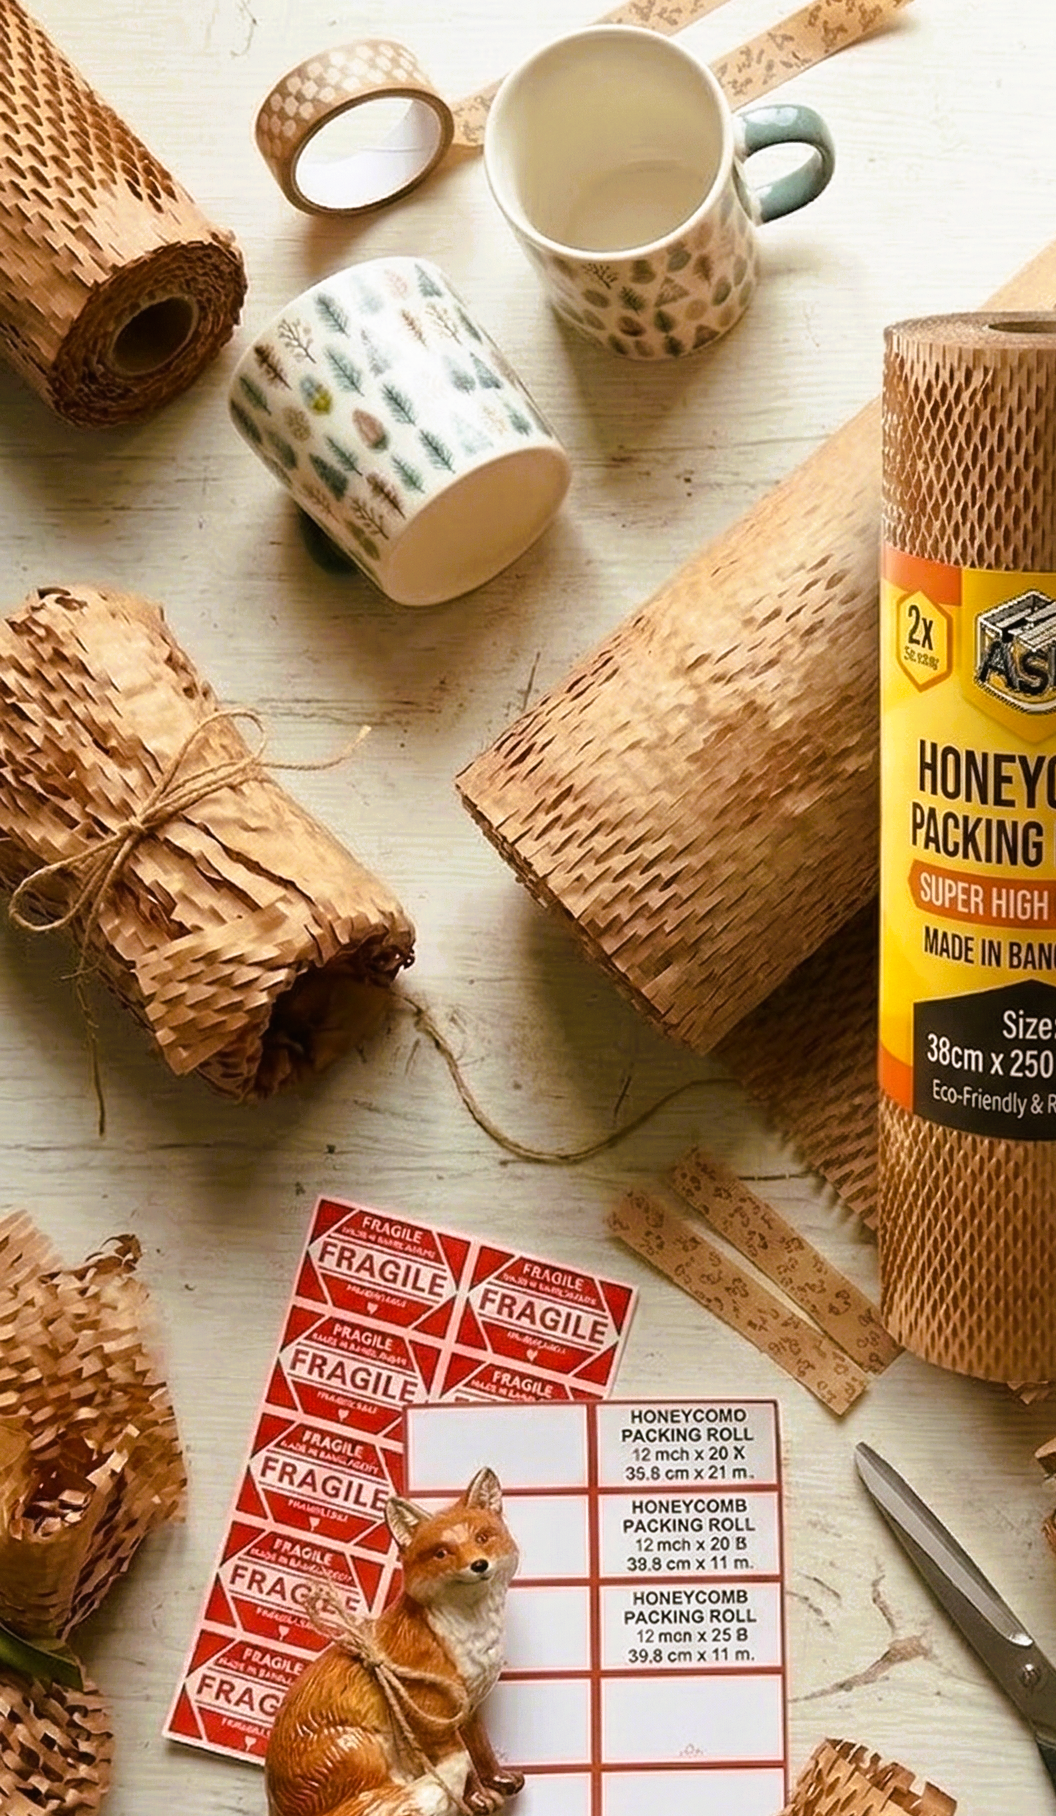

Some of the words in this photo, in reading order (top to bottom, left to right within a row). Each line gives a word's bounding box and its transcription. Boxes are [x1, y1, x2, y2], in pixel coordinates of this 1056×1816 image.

[907, 604, 933, 651] 2x
[912, 801, 1043, 868] PACKING
[920, 872, 984, 916] SUPER
[992, 887, 1049, 921] HIGH
[924, 926, 974, 965] MADE
[981, 938, 1001, 968] IN
[926, 1033, 983, 1073] 38cm
[990, 1052, 1004, 1076] x
[1010, 1048, 1054, 1079] 250
[933, 1079, 1027, 1119] Eco-Friendly
[1030, 1093, 1044, 1115] &
[362, 1216, 423, 1244] FRAGILE
[318, 1241, 448, 1298] FRAGILE
[522, 1263, 584, 1292] FRAGILE
[478, 1288, 609, 1345] FRAGILE
[289, 1348, 418, 1403] FRAGILE
[492, 1371, 553, 1399] FRAGILE
[302, 1430, 363, 1459] FRAGILE
[621, 1427, 702, 1443] PACKING
[706, 1427, 755, 1442] ROLL
[632, 1446, 651, 1461] 12
[694, 1449, 705, 1461] x
[708, 1446, 729, 1460] 20
[260, 1455, 389, 1512] FRAGILE
[664, 1468, 690, 1480] cm
[694, 1468, 705, 1480] x
[708, 1465, 727, 1479] 21
[632, 1499, 748, 1514] HONEYCOMB
[623, 1518, 704, 1534] PACKING
[708, 1517, 756, 1532] ROLL
[636, 1537, 654, 1552] 12
[696, 1540, 706, 1551] x
[710, 1536, 731, 1551] 20
[666, 1559, 691, 1571] cm
[695, 1558, 706, 1571] x
[710, 1556, 727, 1570] 11
[733, 1557, 754, 1570] m.
[633, 1590, 749, 1606] HONEYCOMB
[624, 1609, 705, 1625] PACKING
[709, 1609, 757, 1624] ROLL
[637, 1629, 655, 1643] 12
[697, 1631, 707, 1643] x
[711, 1628, 732, 1642] 25
[628, 1648, 663, 1664] 39.8
[667, 1650, 693, 1663] cm
[697, 1650, 707, 1663] x
[712, 1647, 729, 1661] 11
[735, 1649, 756, 1662] m.
[196, 1674, 280, 1717] FRAG
